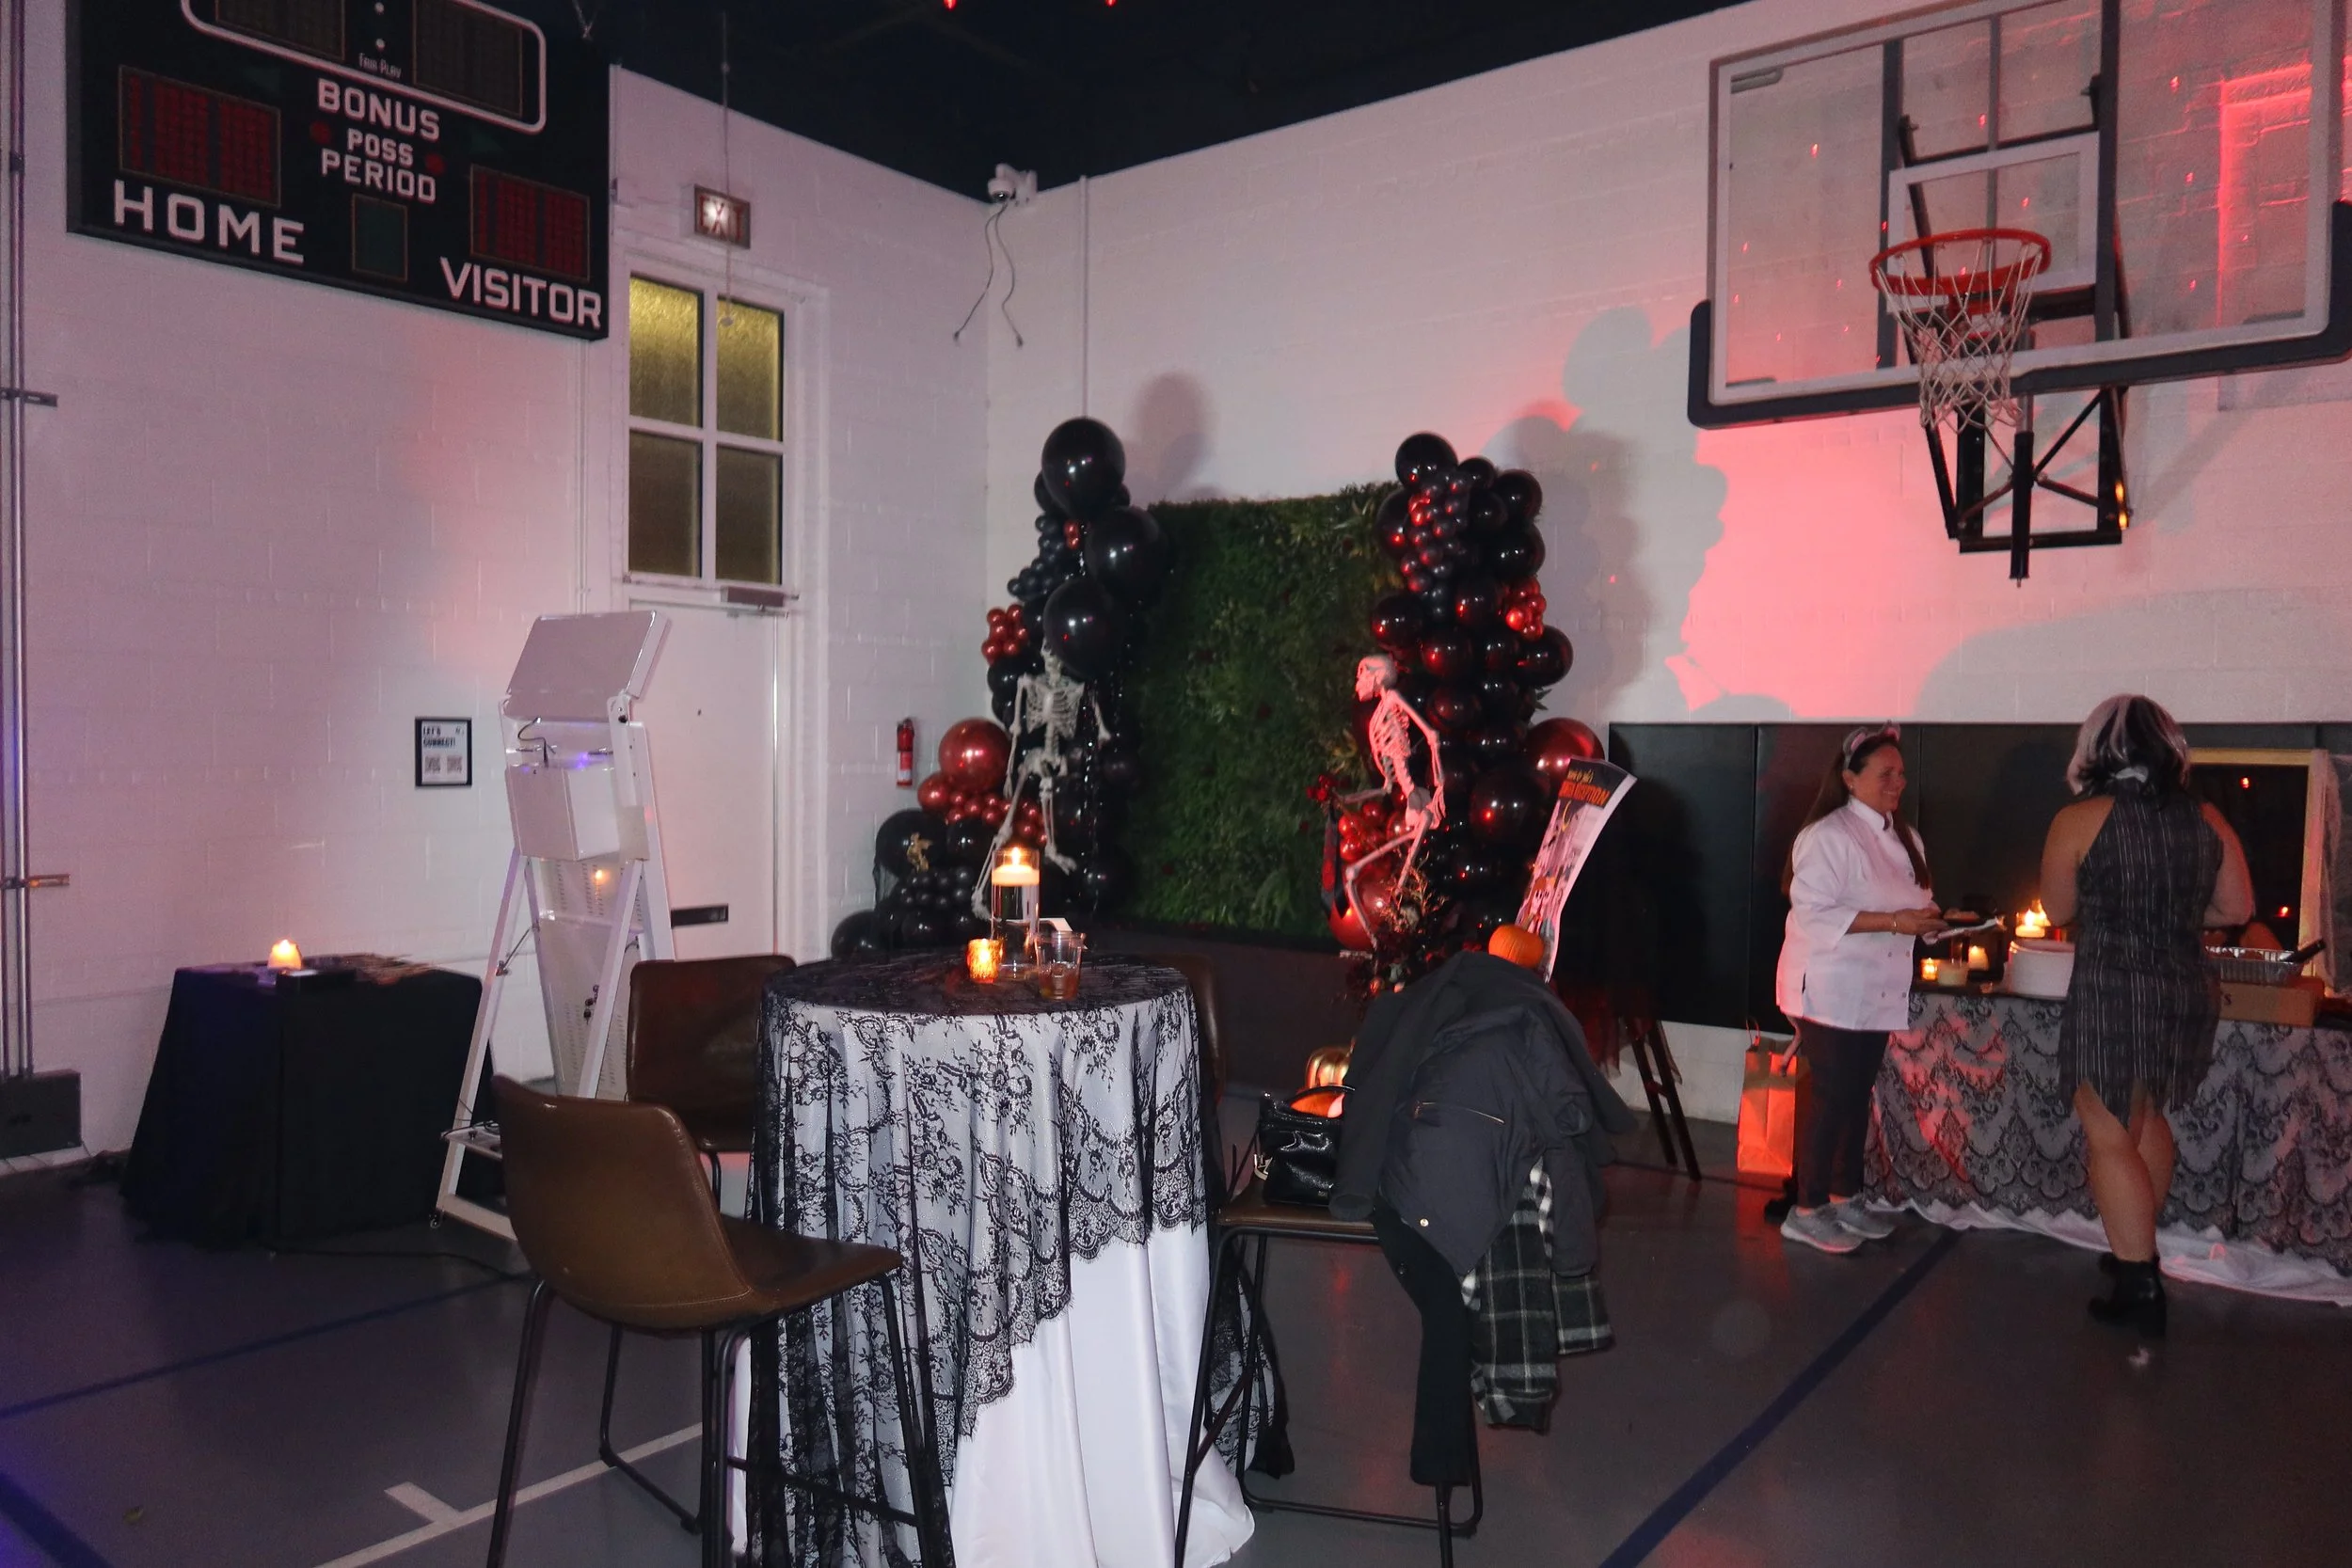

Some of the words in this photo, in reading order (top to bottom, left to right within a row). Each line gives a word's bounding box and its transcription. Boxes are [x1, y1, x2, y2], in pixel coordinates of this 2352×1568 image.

[318, 77, 440, 142] BONUS
[322, 148, 437, 204] PERIOD
[347, 127, 414, 167] POSS
[114, 178, 305, 264] HOME
[699, 195, 744, 242] EXIT
[439, 256, 602, 329] VISITOR
